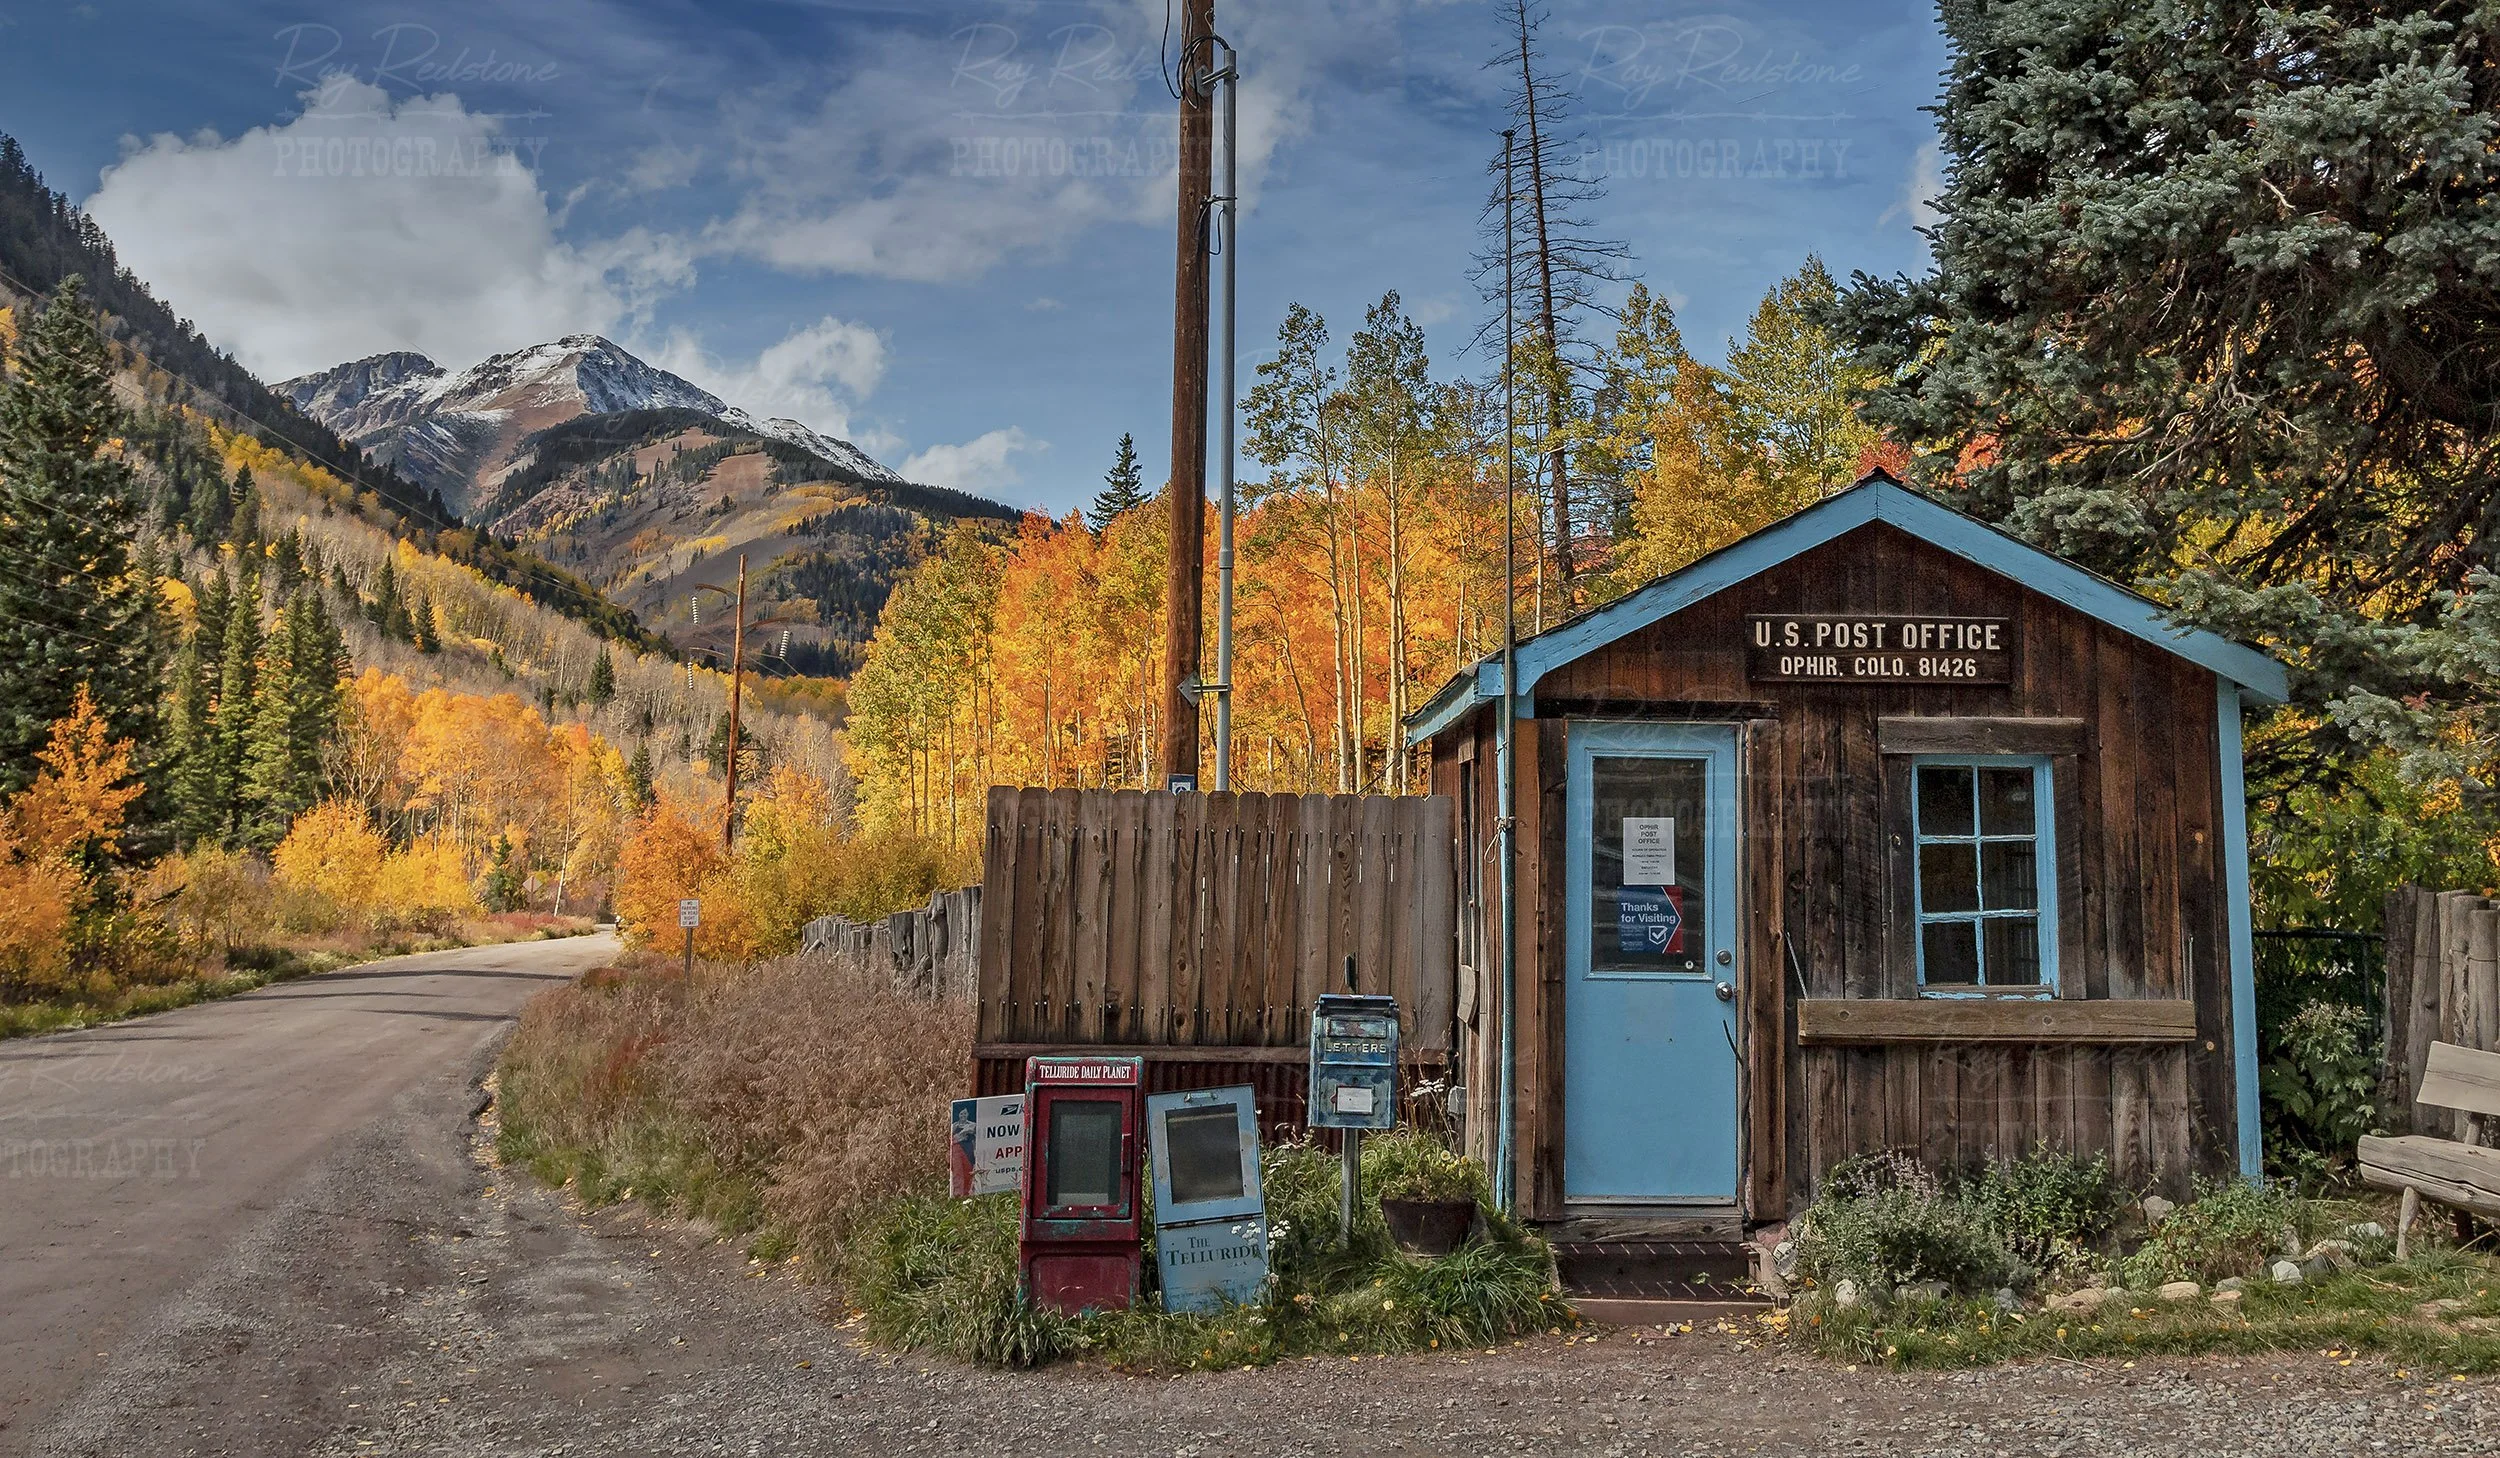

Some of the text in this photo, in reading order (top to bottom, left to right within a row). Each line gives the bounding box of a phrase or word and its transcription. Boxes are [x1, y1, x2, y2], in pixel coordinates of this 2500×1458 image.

[1816, 623, 1886, 648] POST
[1903, 624, 2000, 650] OFFICE
[1855, 657, 1910, 676] COLO.
[1919, 657, 1977, 677] 81426
[1621, 902, 1659, 912] Thanks
[1621, 913, 1676, 925] for Visiting
[1325, 1043, 1387, 1053] LETTERS
[1040, 1065, 1131, 1079] TELLURIDE DAILY PLANET
[986, 1124, 1020, 1138] NOW
